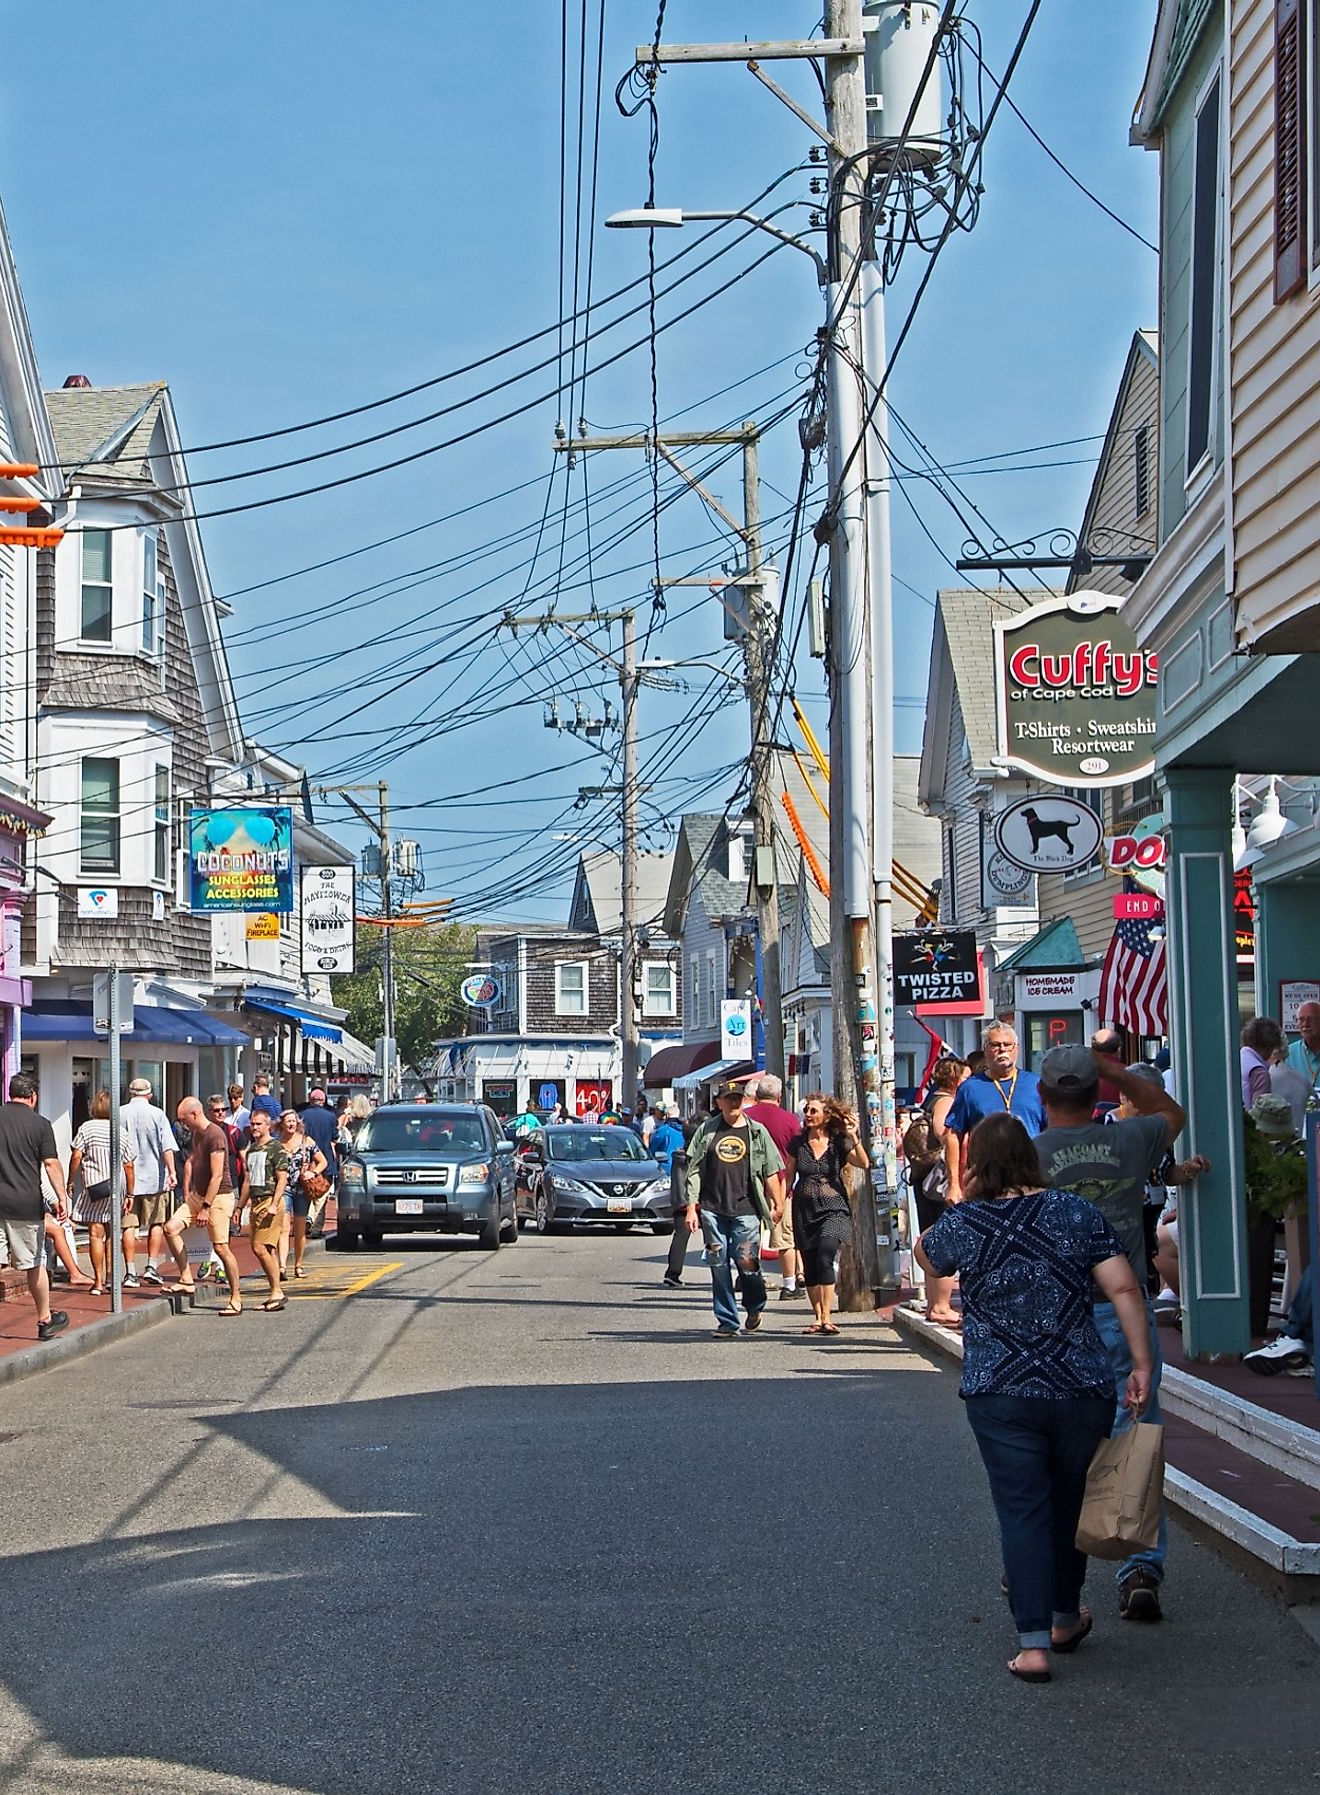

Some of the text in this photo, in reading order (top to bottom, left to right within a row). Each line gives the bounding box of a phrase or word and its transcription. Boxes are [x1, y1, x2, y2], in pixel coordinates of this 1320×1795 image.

[1010, 686, 1114, 702] of Cape Cod
[1014, 722, 1072, 739] T-Shirts
[1051, 738, 1135, 755] Resortwear
[1086, 761, 1103, 771] 291
[1110, 834, 1166, 870] DO
[197, 849, 290, 873] COCONUTS
[208, 874, 277, 887] SUNGLASSES
[206, 887, 280, 900] ACCESSORIES
[304, 890, 352, 906] MAYFLOWER
[1126, 900, 1149, 913] END
[897, 970, 976, 988] TWISTED
[1025, 976, 1076, 987] HOMEMADE
[911, 986, 964, 1001] PIZZA
[1027, 986, 1074, 996] ICE CREAM
[727, 1018, 746, 1030] Art
